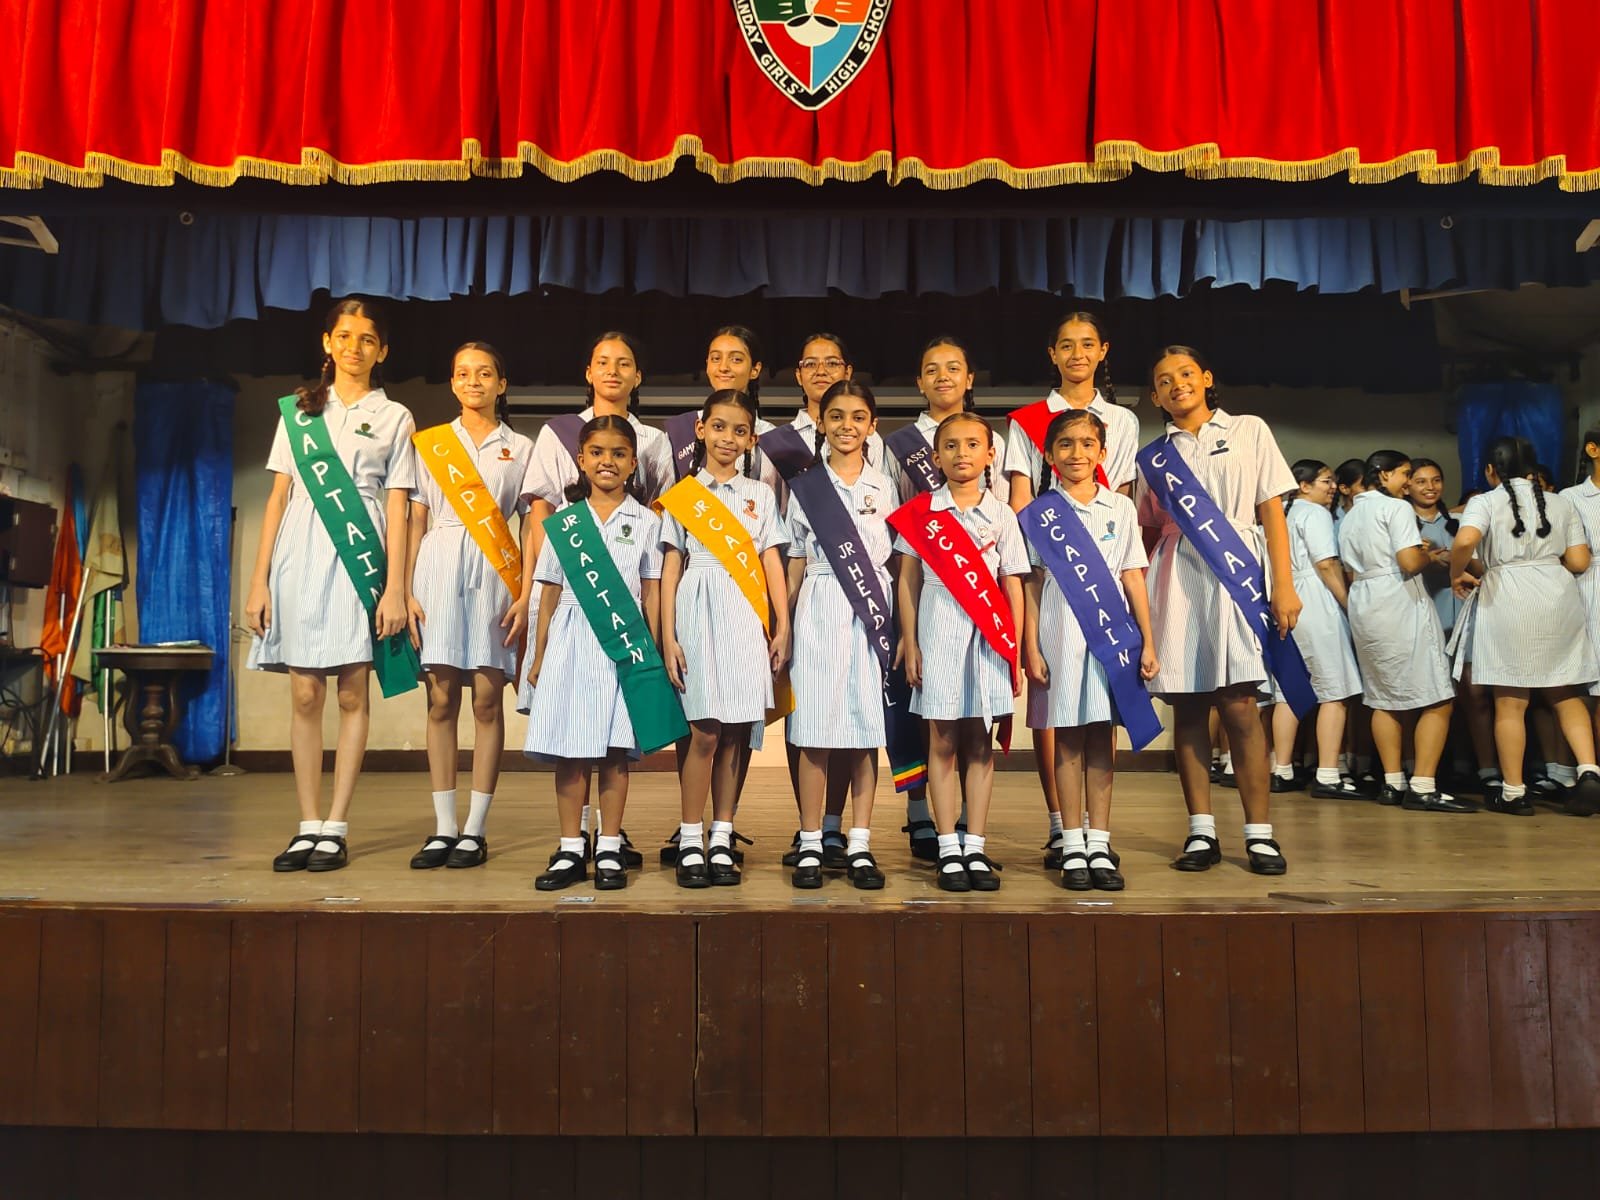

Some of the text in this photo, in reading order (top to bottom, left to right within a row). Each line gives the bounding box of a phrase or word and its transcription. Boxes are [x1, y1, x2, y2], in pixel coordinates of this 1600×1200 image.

[824, 59, 858, 94] HIGH
[906, 446, 928, 466] ASST
[709, 517, 768, 606] CAPT
[924, 518, 943, 540] JR
[569, 532, 644, 665] CAPTAIN
[838, 541, 856, 559] JR
[848, 562, 885, 630] HEAD
[1050, 525, 1130, 667] CAPTAIN
